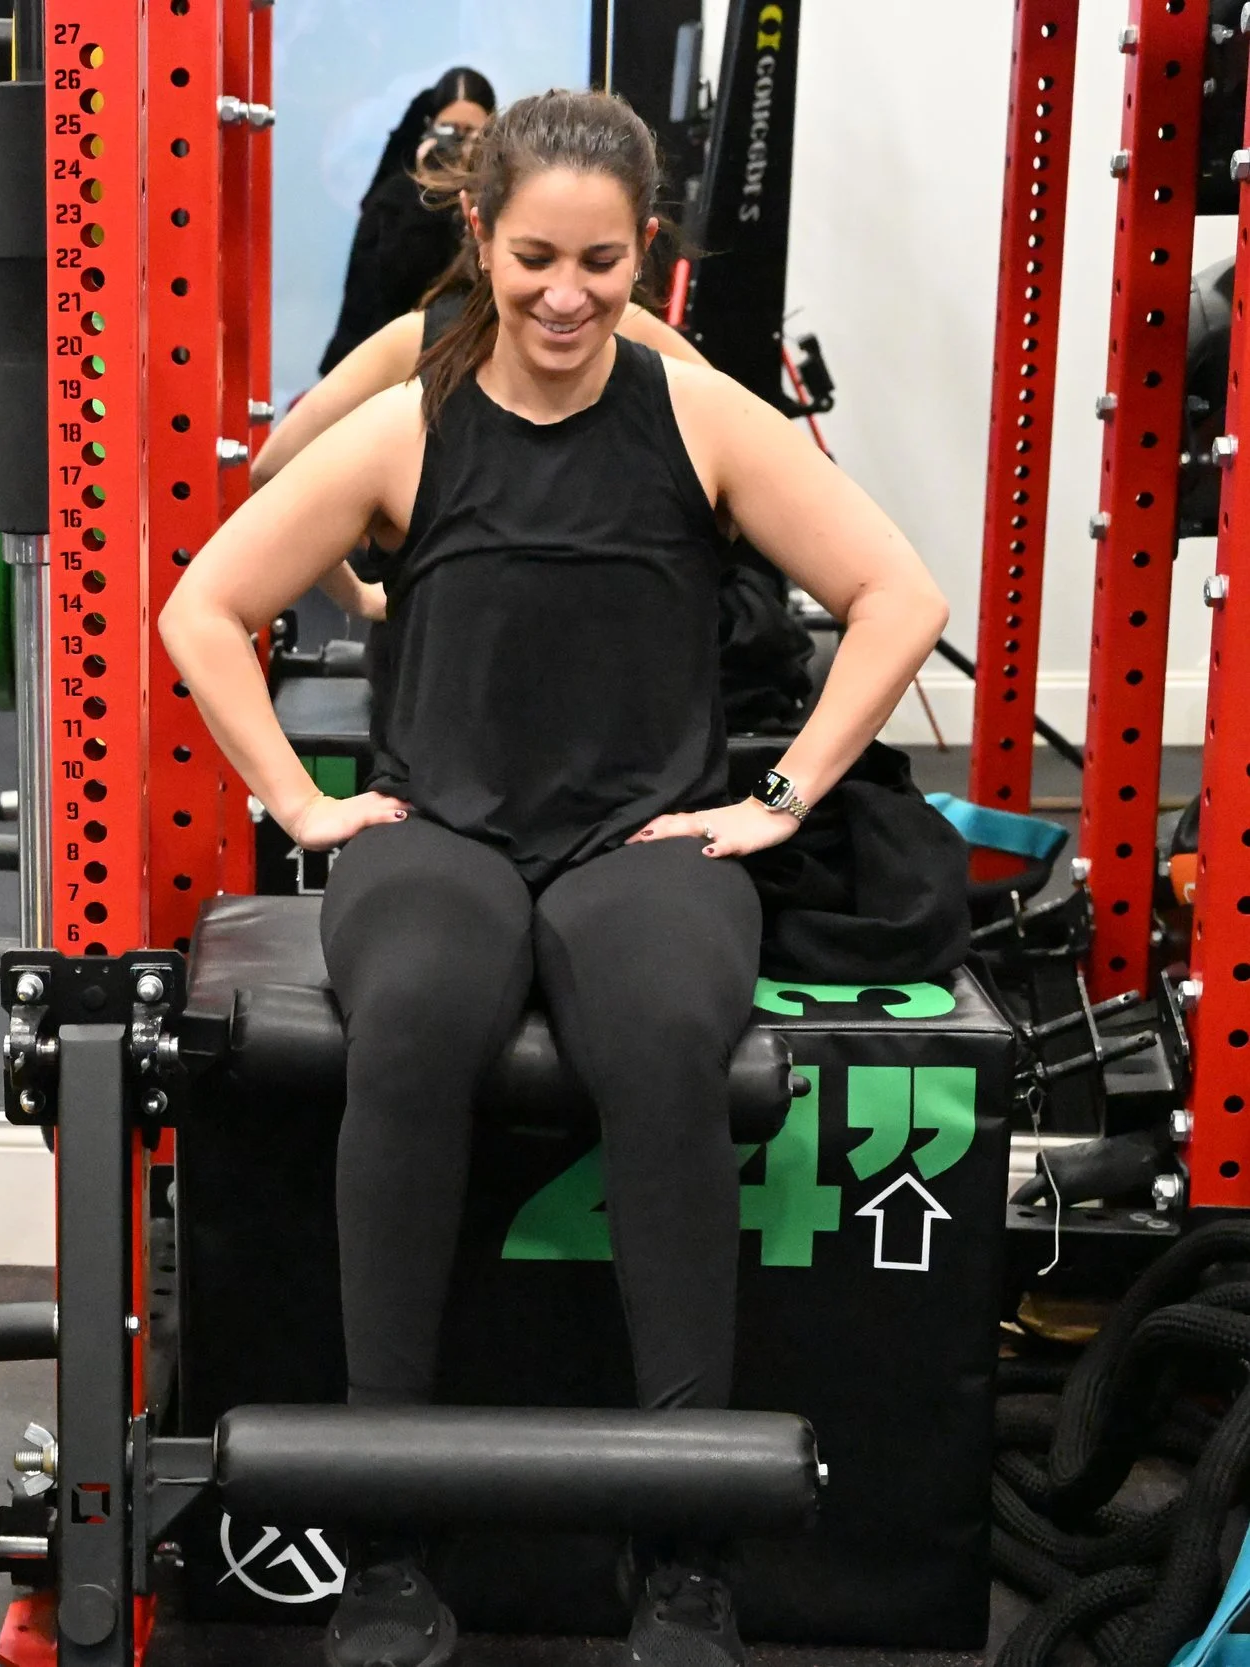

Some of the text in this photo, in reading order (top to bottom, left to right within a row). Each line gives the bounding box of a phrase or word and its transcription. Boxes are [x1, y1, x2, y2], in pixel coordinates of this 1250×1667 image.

[54, 23, 81, 45] 27
[54, 69, 81, 90] 26
[55, 114, 81, 135] 25
[54, 159, 82, 180] 24
[56, 204, 82, 224] 23
[56, 248, 82, 269] 22
[58, 292, 81, 312] 21
[57, 335, 82, 356] 20
[59, 379, 81, 399] 19
[59, 423, 82, 442] 18
[60, 466, 81, 485] 17
[60, 509, 82, 528] 16
[61, 551, 82, 571] 15
[60, 594, 83, 613] 14
[61, 635, 83, 655] 13
[61, 678, 83, 697] 12
[63, 719, 82, 738] 11
[61, 760, 84, 779] 10
[67, 802, 79, 820] 9
[67, 843, 79, 861] 8
[68, 883, 79, 901] 7
[67, 924, 80, 942] 6
